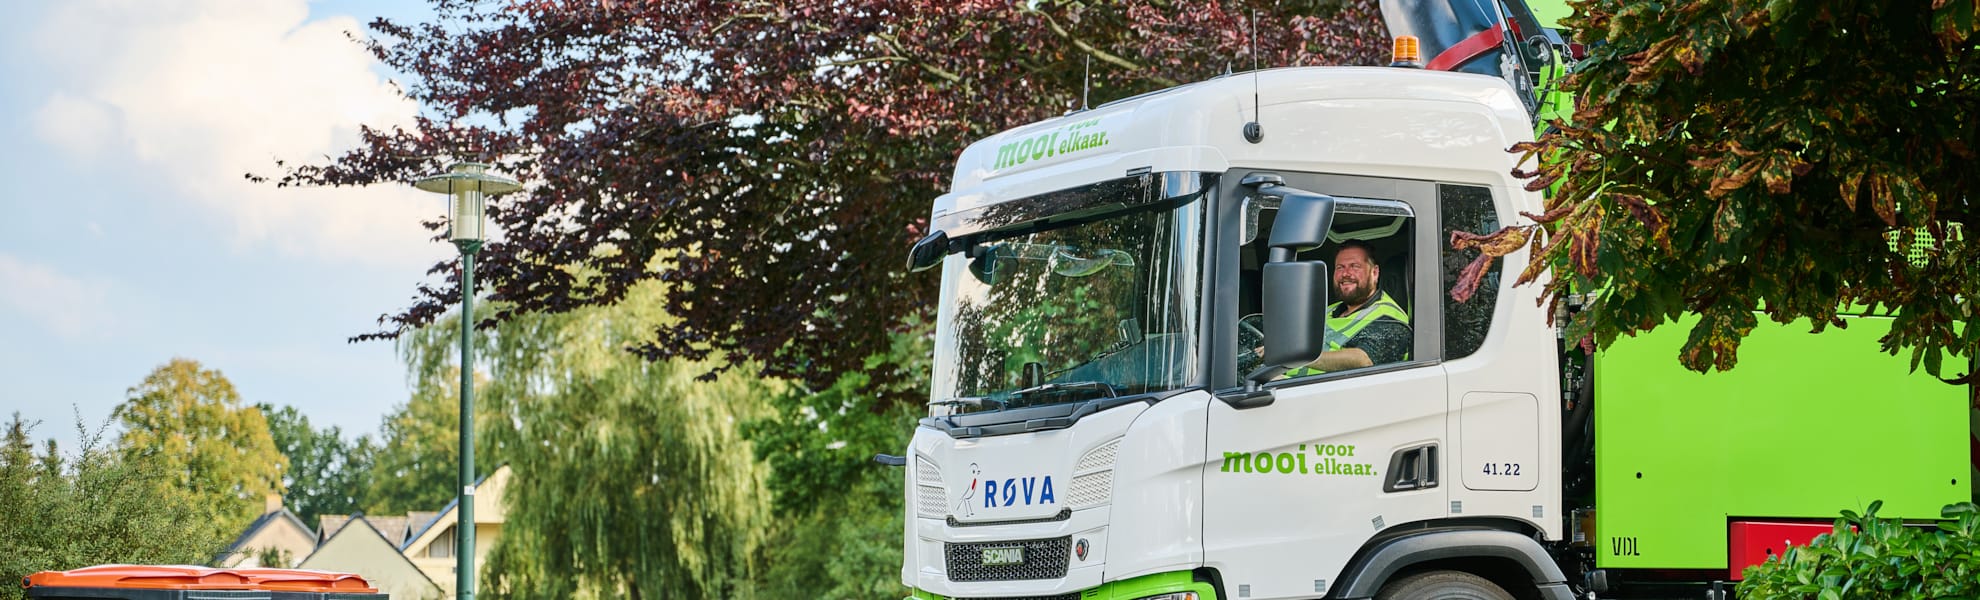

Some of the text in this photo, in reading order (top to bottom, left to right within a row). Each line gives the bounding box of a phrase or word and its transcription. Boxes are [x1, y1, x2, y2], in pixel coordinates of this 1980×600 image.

[1058, 131, 1109, 154] elkaar.
[1221, 444, 1355, 474] mooi voor
[1314, 458, 1377, 476] elkaar.
[1483, 463, 1521, 476] 41.22
[982, 548, 1023, 563] SCANIA
[1612, 537, 1640, 556] VDL
